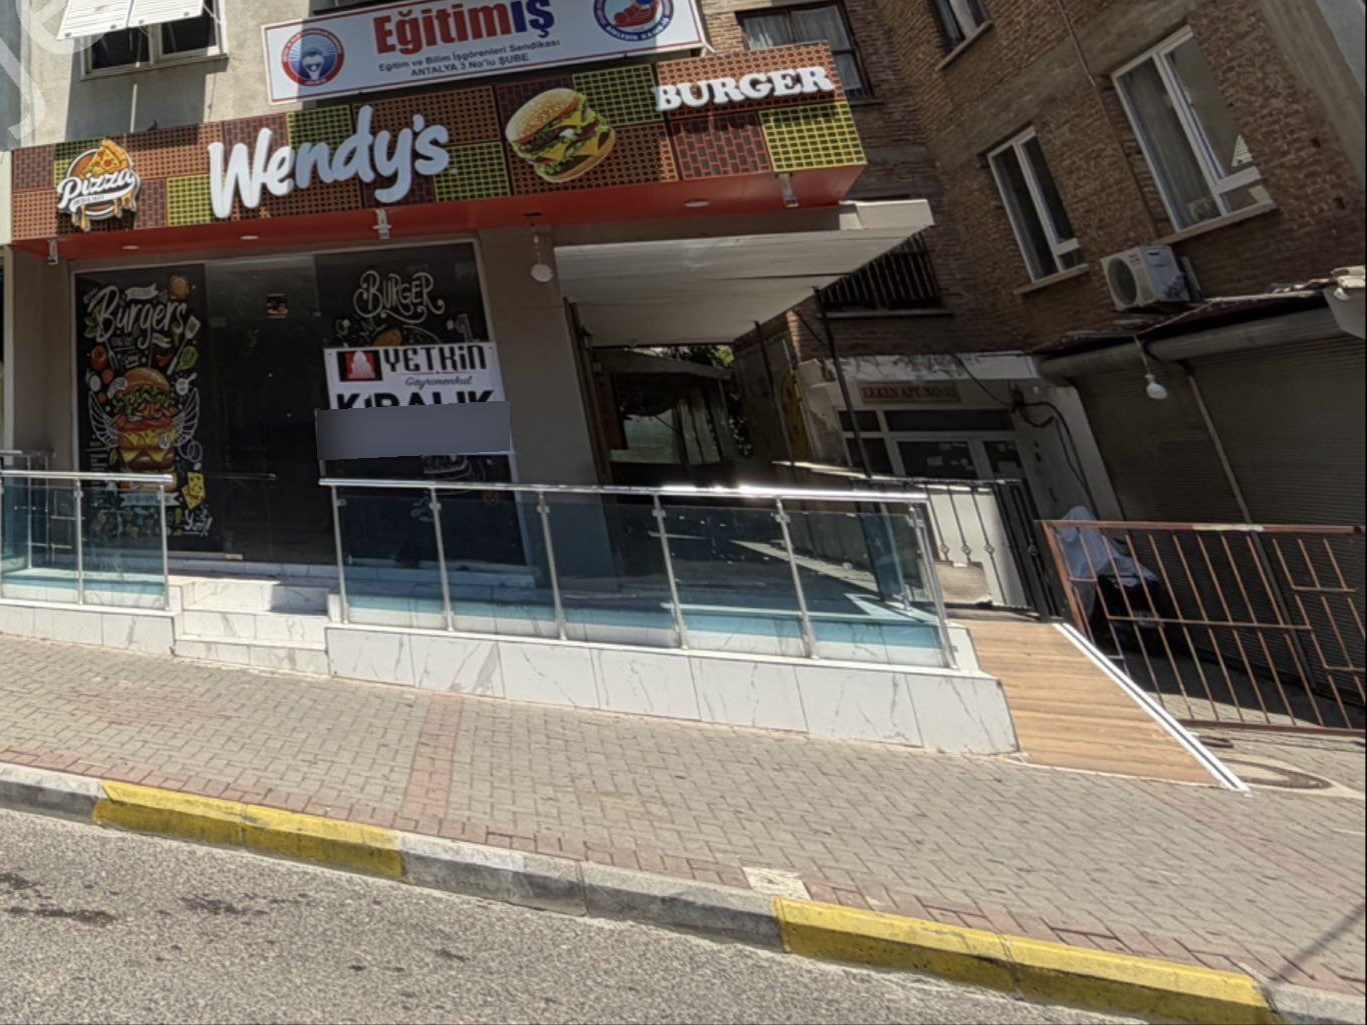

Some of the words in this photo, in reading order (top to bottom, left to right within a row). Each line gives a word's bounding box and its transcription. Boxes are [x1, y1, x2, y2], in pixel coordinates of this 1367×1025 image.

[378, 59, 410, 72] Eğitim
[411, 59, 424, 67] ve
[425, 54, 451, 65] Bilim
[509, 39, 561, 53] Sendikası
[410, 62, 458, 77] ANTALYA
[498, 52, 530, 66] ŞUBE
[650, 65, 836, 113] BURGER
[207, 104, 451, 219] Wendy's
[56, 166, 138, 210] Pizza
[87, 285, 188, 350] Burgers
[353, 269, 445, 324] BURGER
